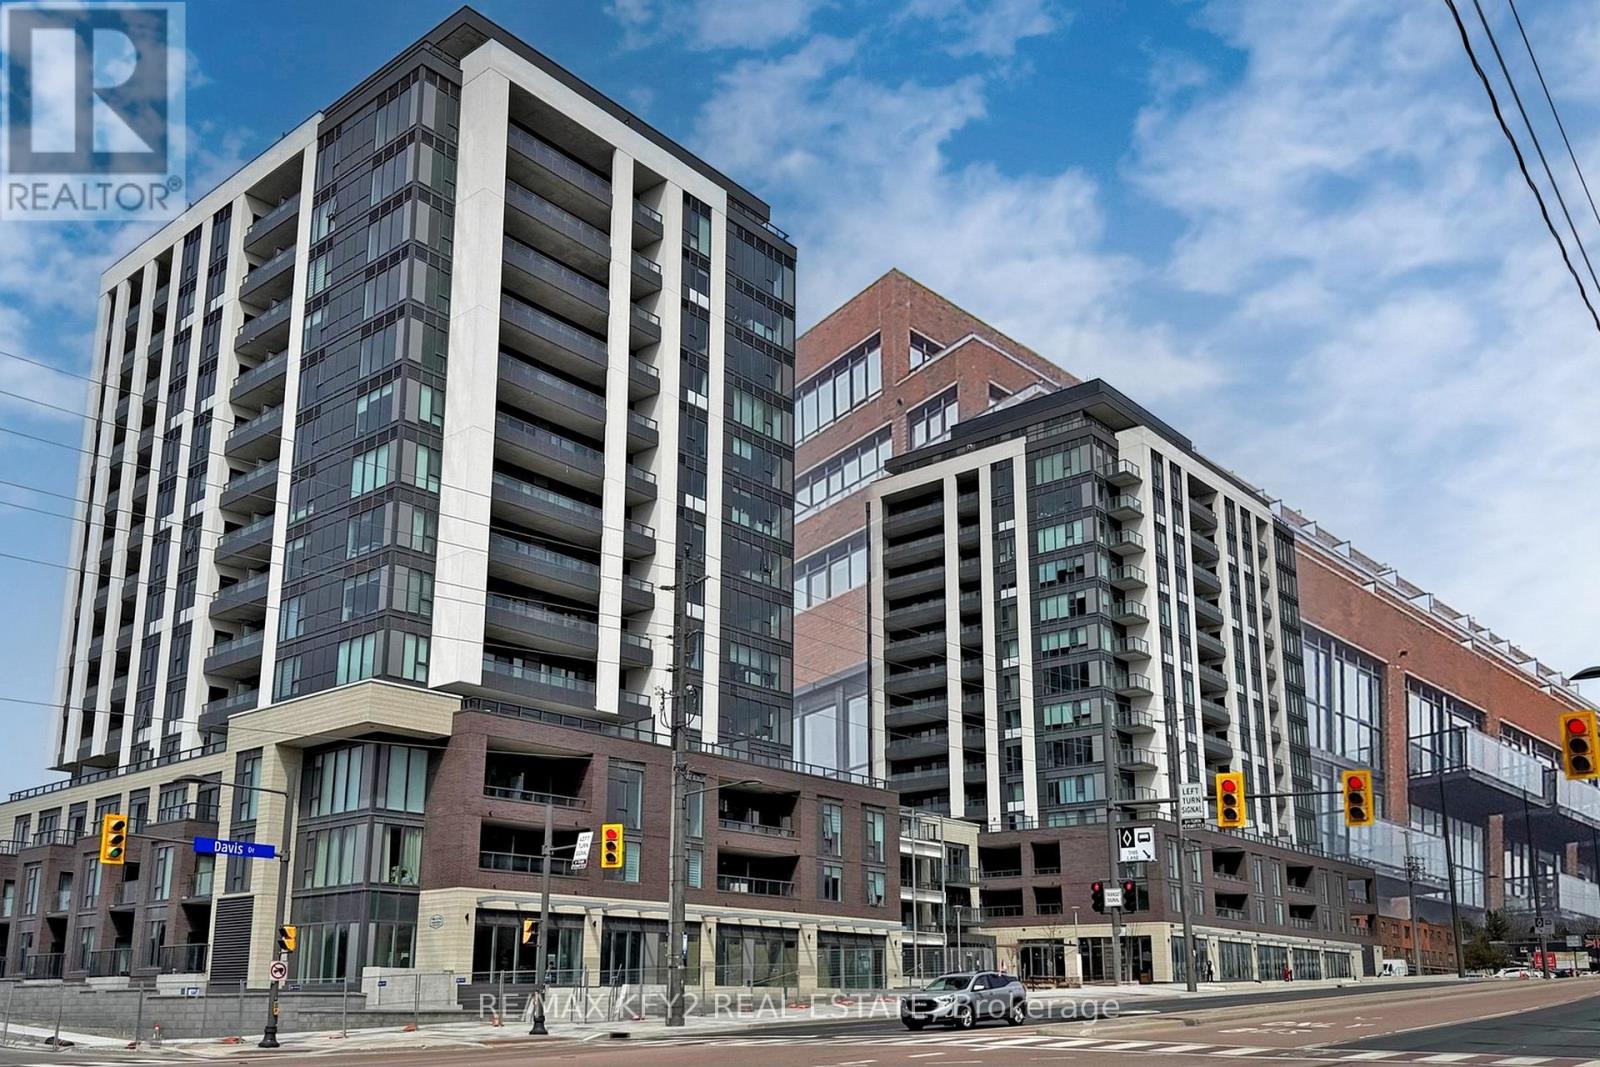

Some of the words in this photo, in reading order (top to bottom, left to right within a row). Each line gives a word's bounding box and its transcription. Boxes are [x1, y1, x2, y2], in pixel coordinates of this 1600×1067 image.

[1182, 787, 1199, 796] LEFT
[1182, 796, 1201, 804] TURN
[1181, 806, 1202, 814] SIGNAL
[214, 841, 243, 855] Davis
[247, 846, 255, 854] Dr
